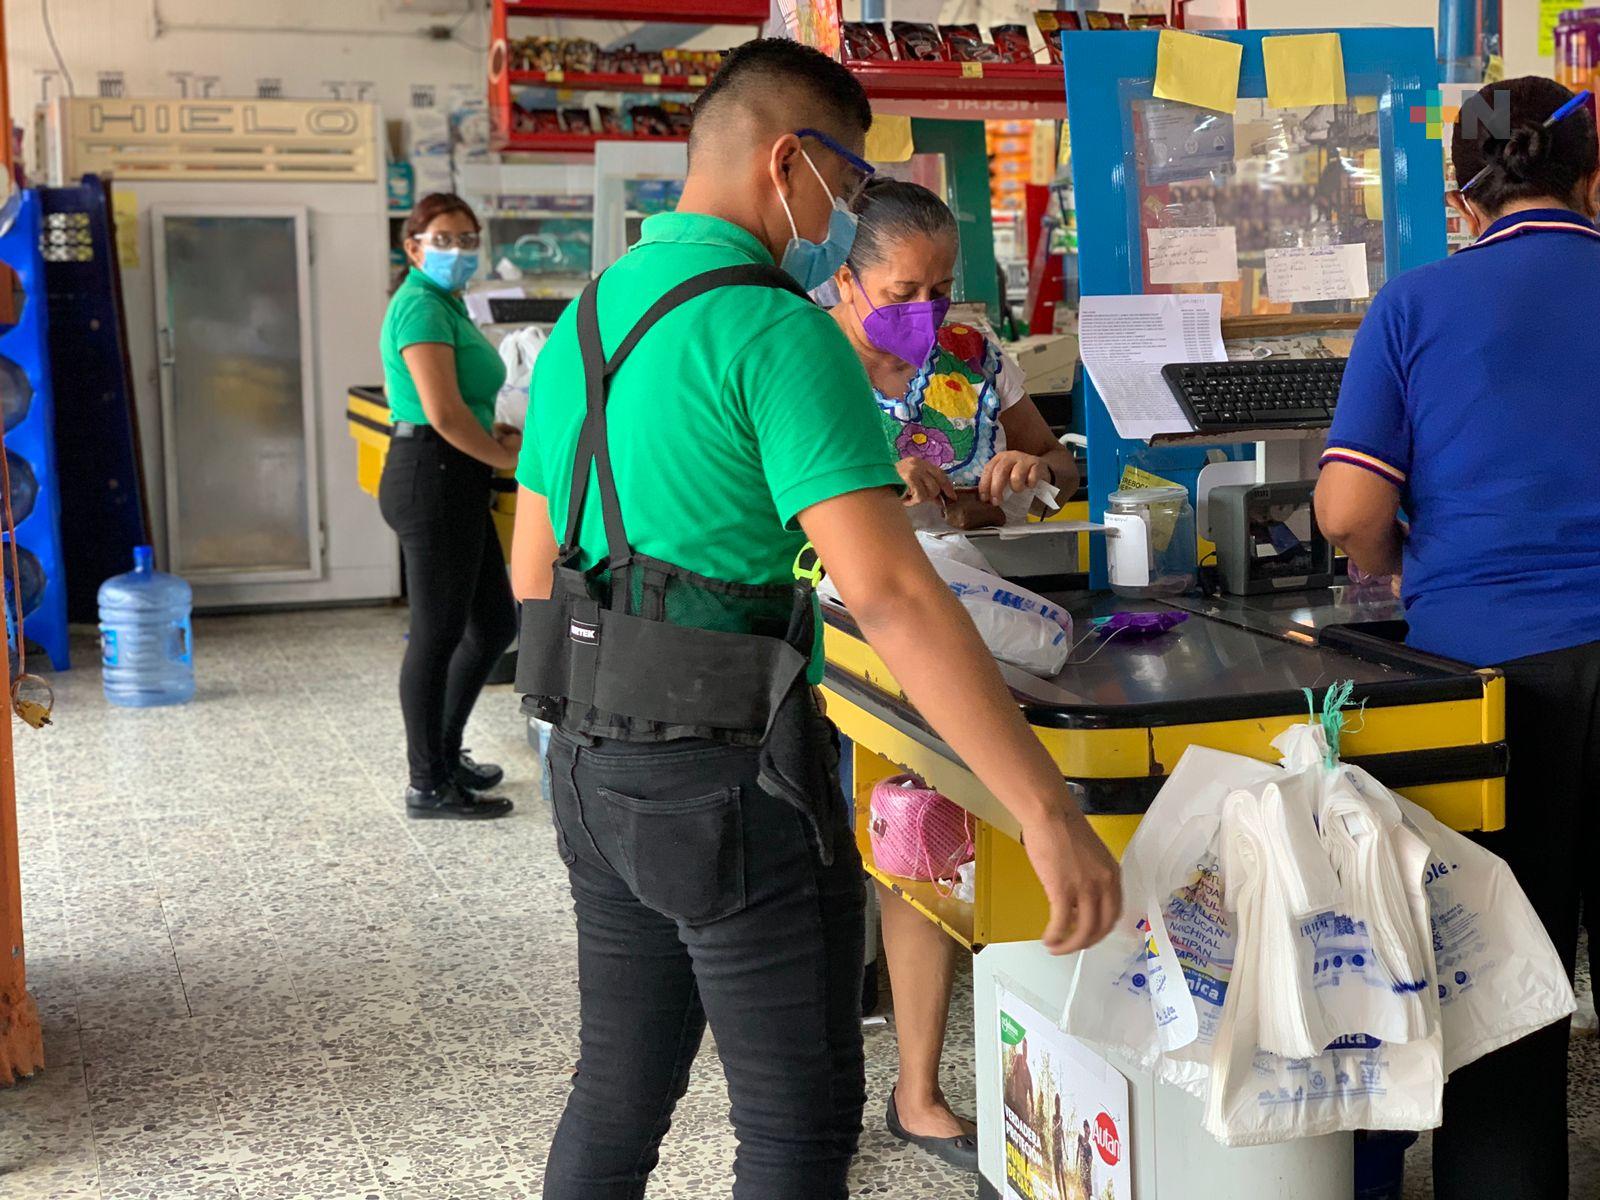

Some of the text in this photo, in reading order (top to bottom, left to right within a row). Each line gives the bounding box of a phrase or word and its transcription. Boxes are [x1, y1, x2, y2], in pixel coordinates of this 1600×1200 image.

[90, 104, 358, 135] HIELO
[1004, 1103, 1042, 1152] VERDADERA
[1092, 1119, 1121, 1162] Autan
